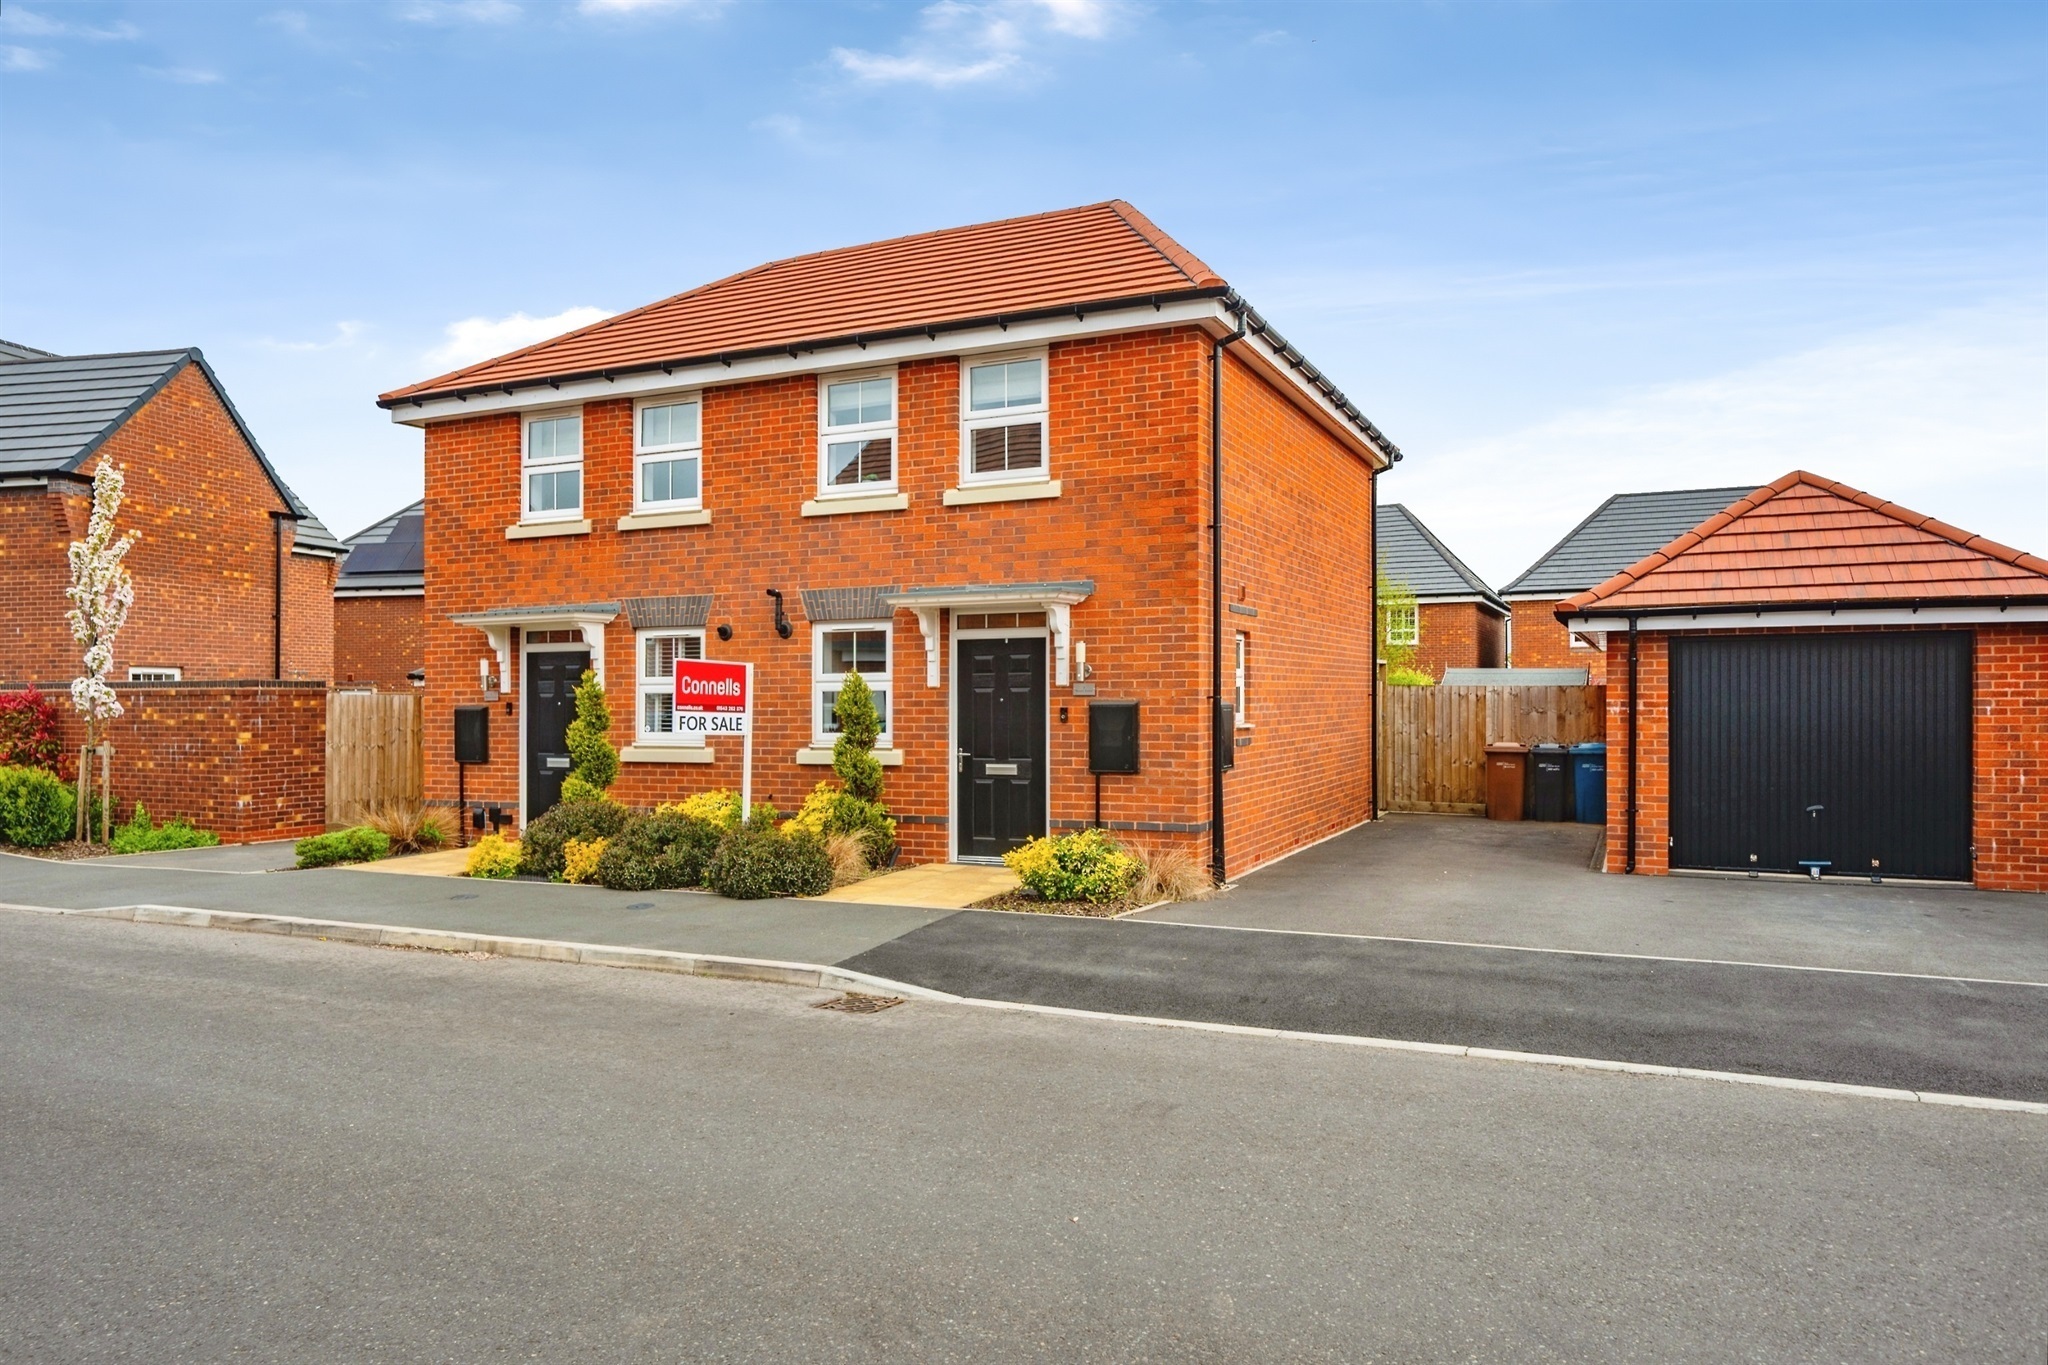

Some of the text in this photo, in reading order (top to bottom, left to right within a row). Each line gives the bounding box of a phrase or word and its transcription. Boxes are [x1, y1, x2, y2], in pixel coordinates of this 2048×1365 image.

[681, 675, 741, 696] Connells
[679, 715, 743, 732] FOR SALE
